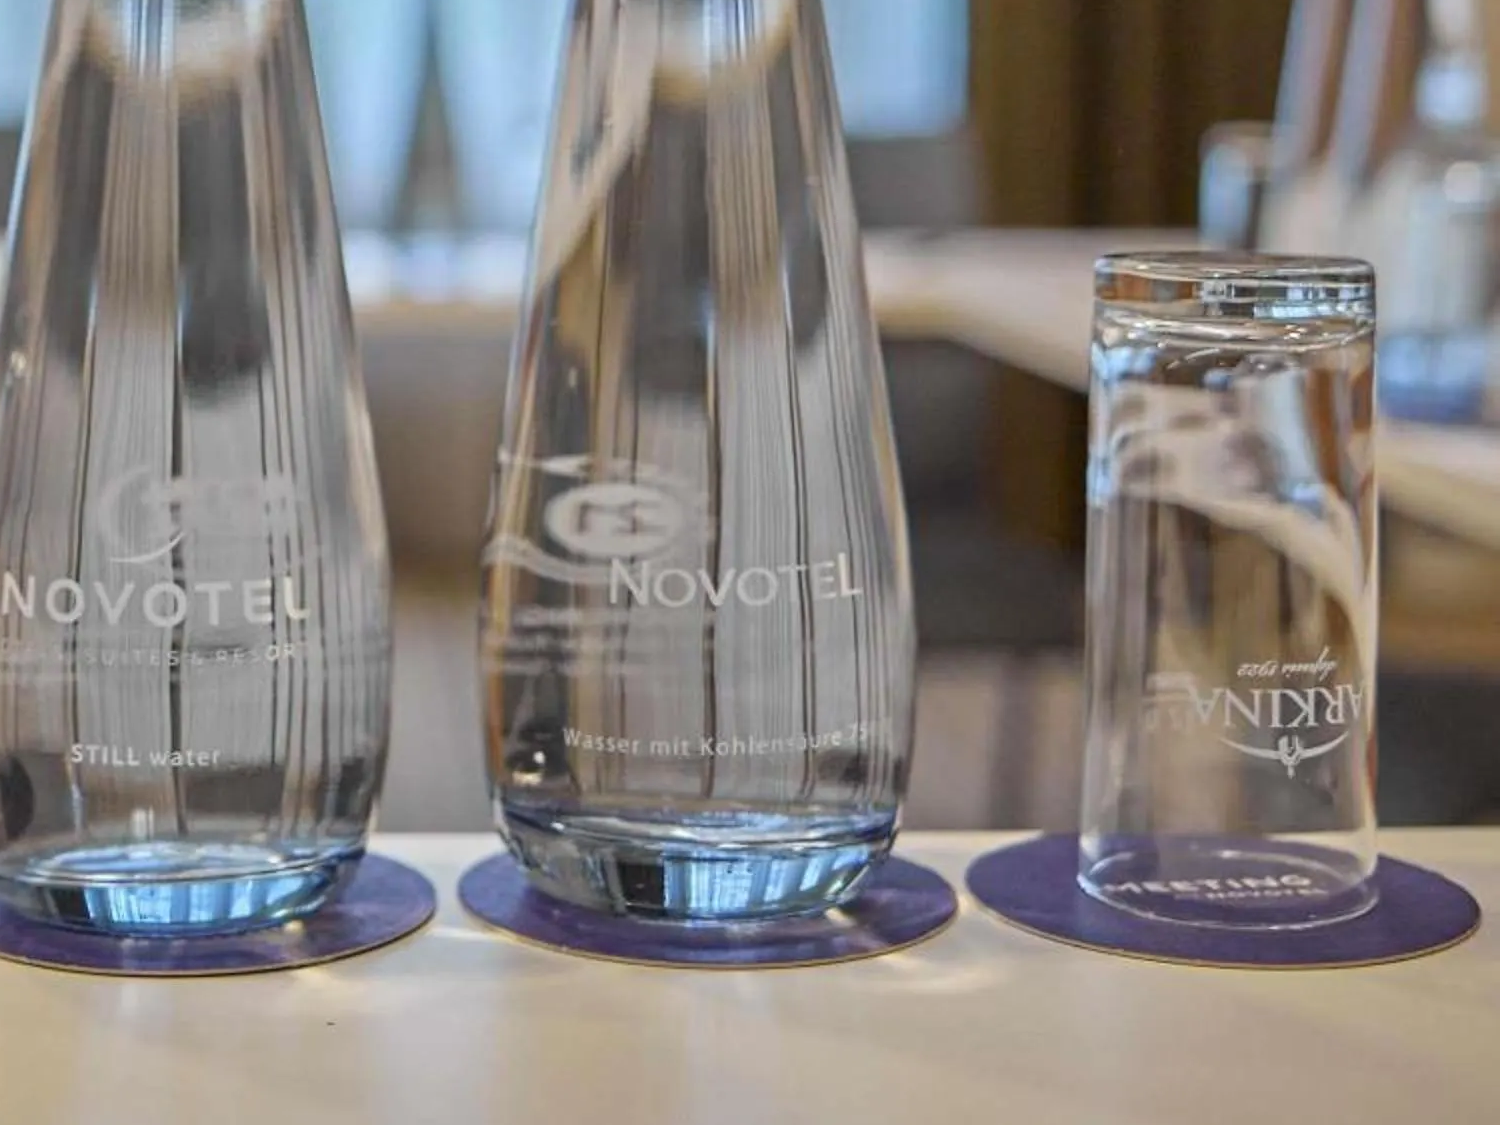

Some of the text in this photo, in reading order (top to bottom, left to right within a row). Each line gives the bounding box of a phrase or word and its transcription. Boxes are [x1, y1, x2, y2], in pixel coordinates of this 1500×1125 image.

[0, 571, 314, 628] NOVOTEL
[608, 551, 864, 609] NOVOTEL
[1188, 683, 1364, 729] ARKINA
[70, 742, 221, 767] STILL water
[562, 727, 640, 755] Wasser
[650, 737, 691, 757] mit
